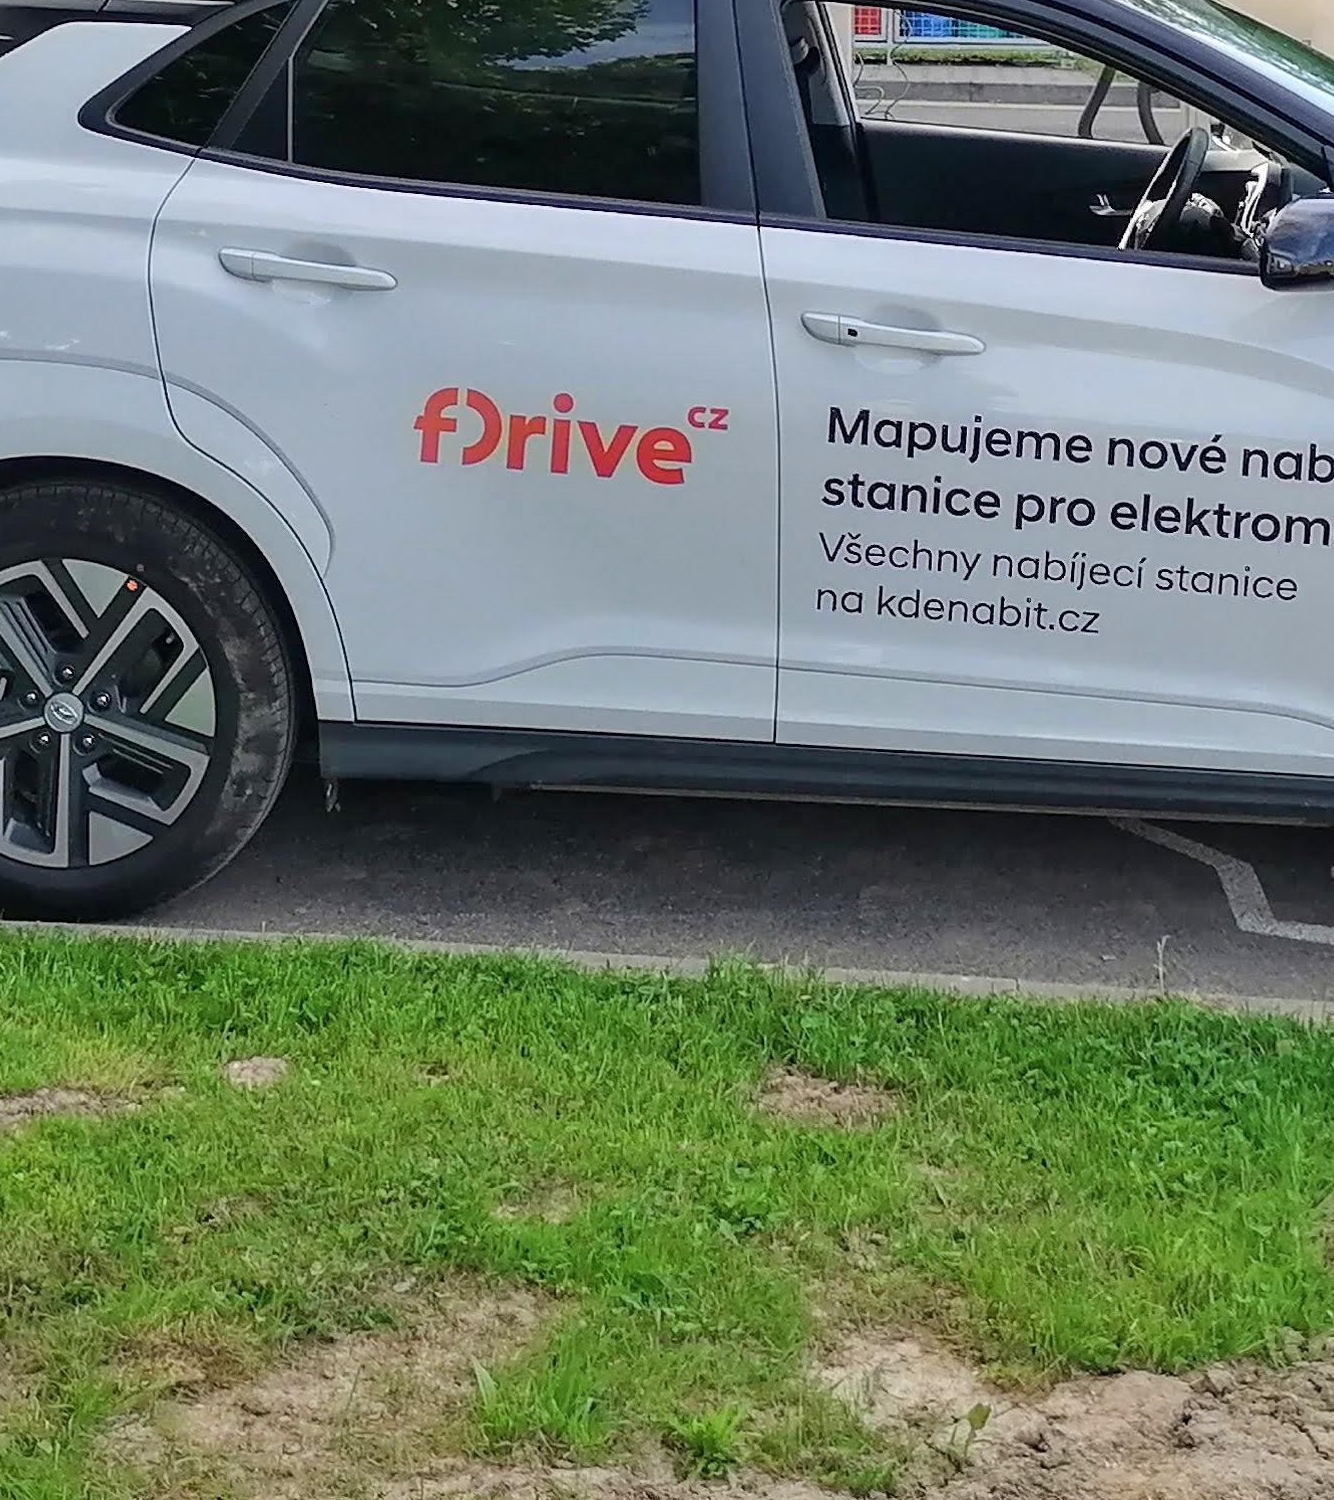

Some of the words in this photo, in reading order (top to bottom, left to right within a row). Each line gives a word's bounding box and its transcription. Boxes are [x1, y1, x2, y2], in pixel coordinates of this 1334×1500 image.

[414, 387, 693, 485] fDrive
[827, 406, 1093, 464] Mapujeme
[1107, 434, 1227, 475] nové
[821, 472, 1001, 519] stanice
[1014, 492, 1096, 531] pro
[819, 531, 982, 581] Všechny
[992, 550, 1148, 592] nabíjecí
[1155, 565, 1299, 601] stanice
[815, 587, 864, 614] na
[877, 585, 1100, 634] kdenabit.cz
